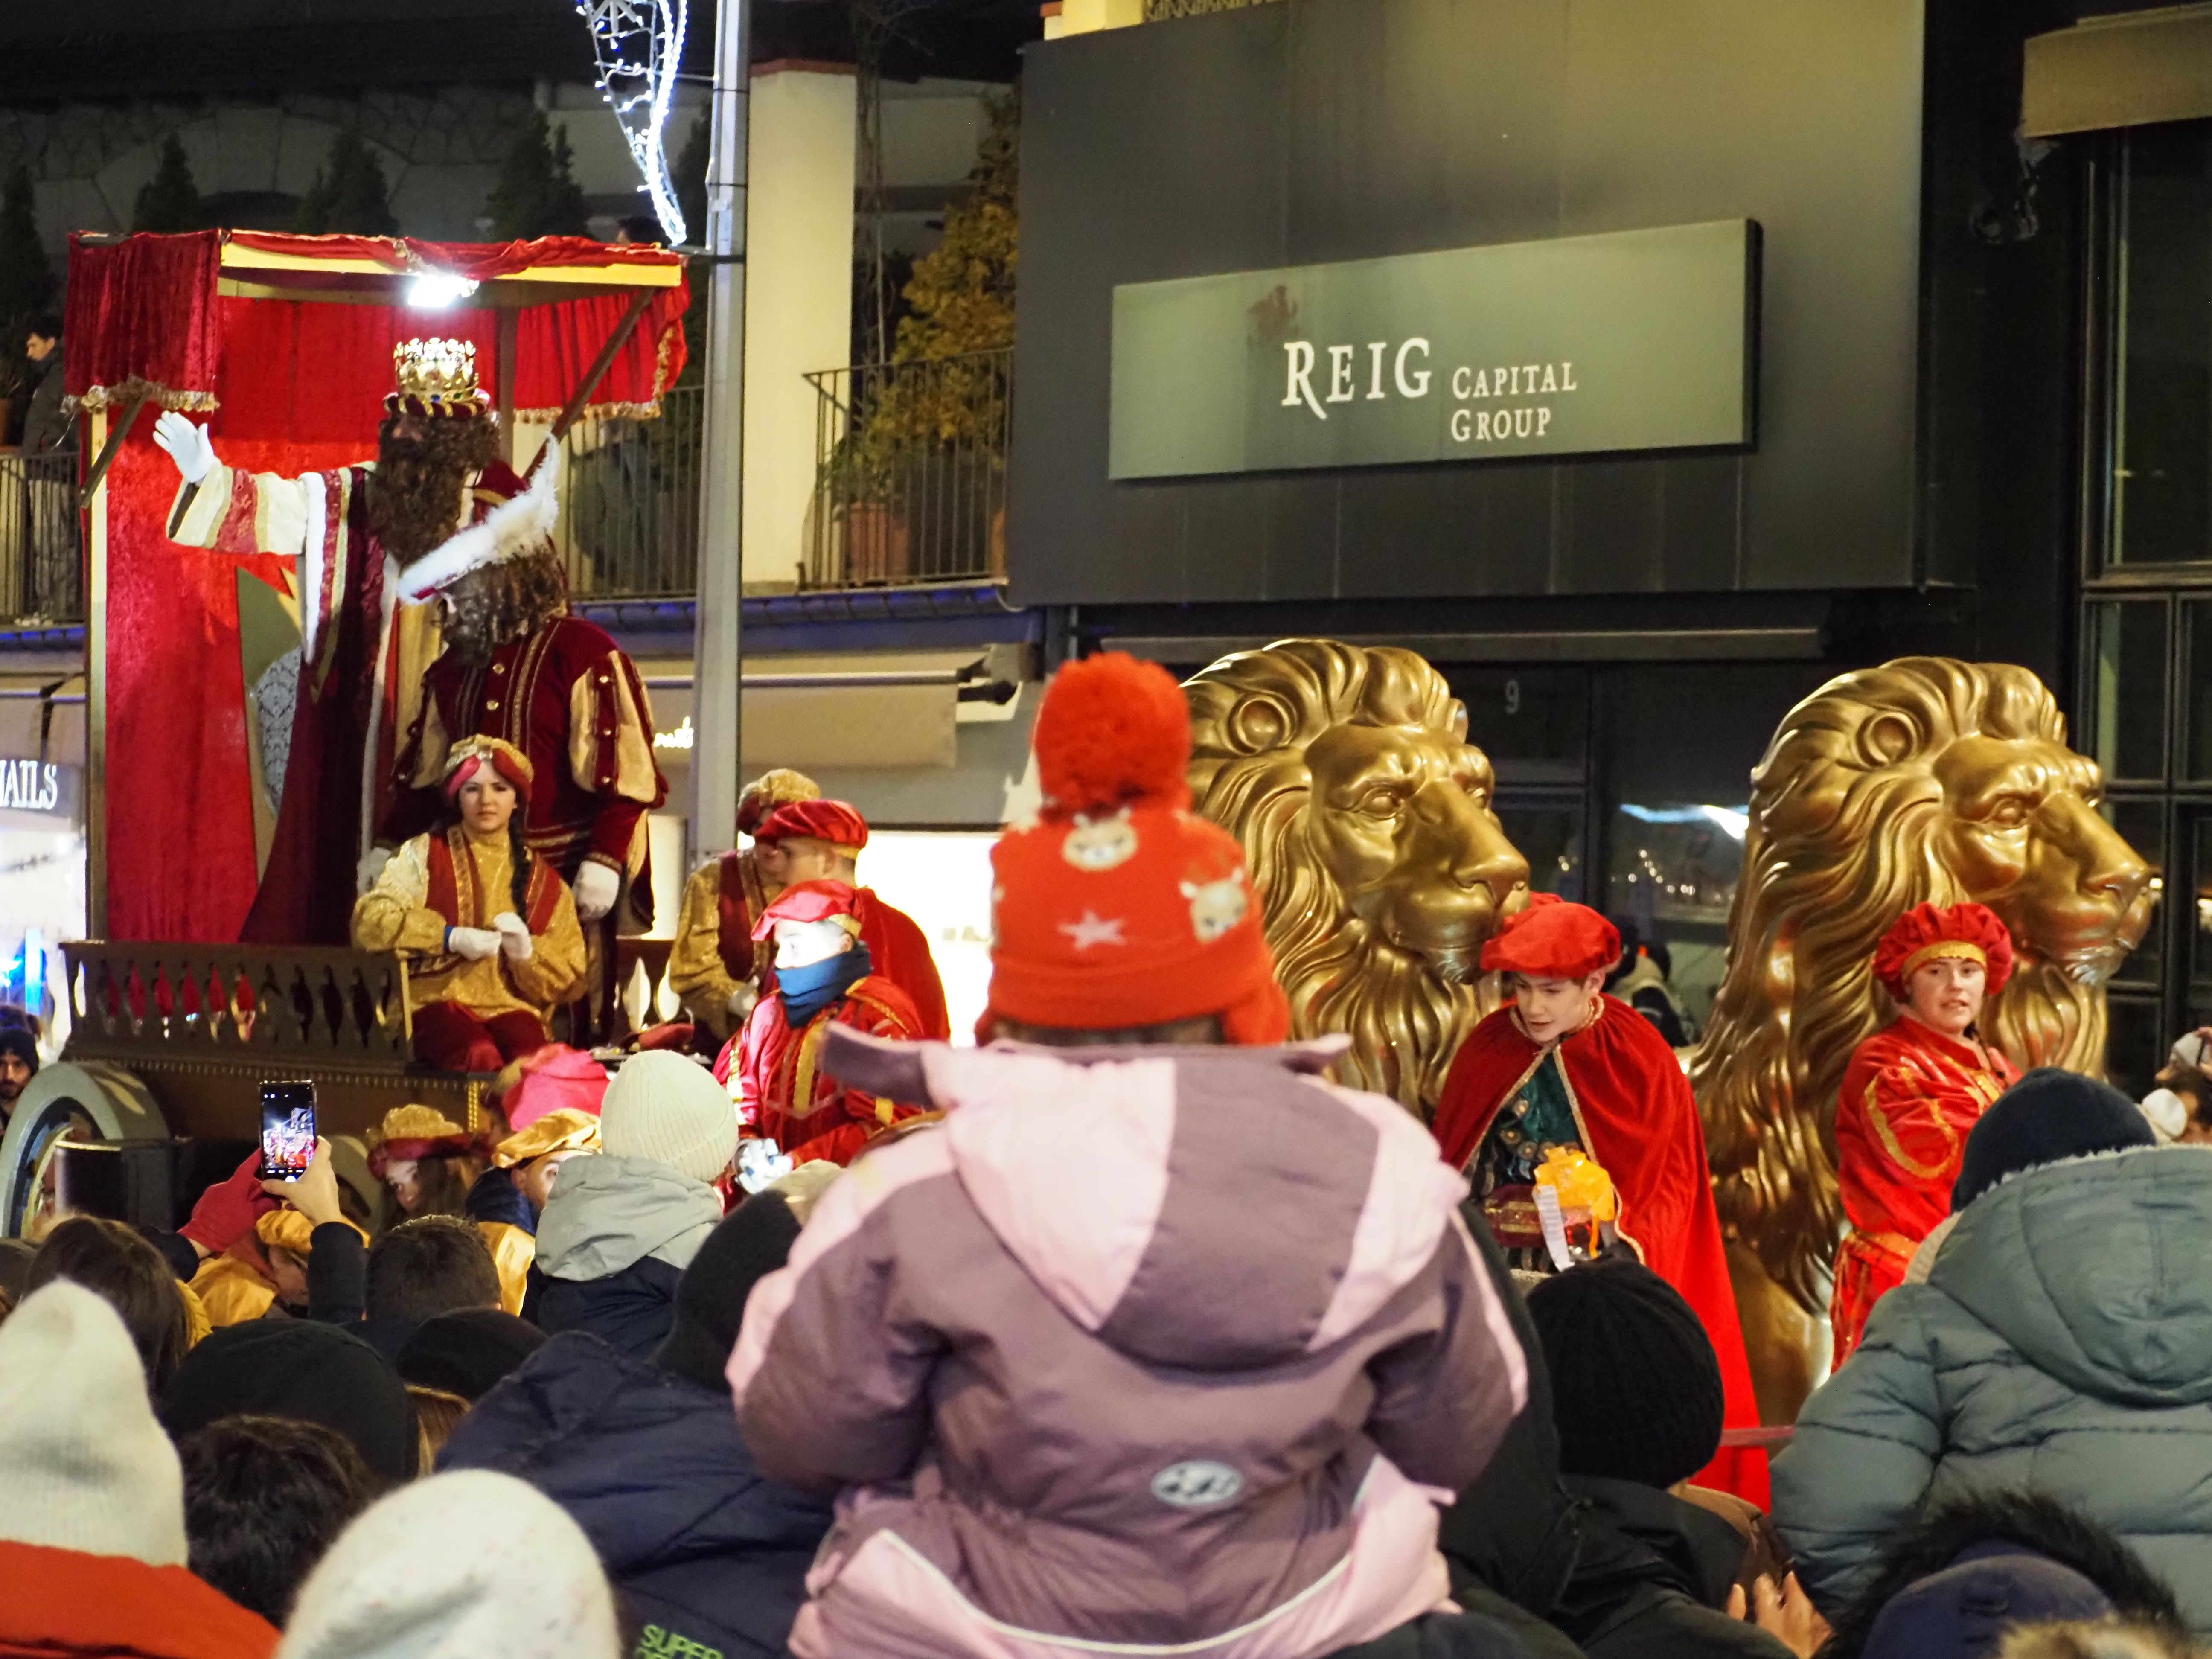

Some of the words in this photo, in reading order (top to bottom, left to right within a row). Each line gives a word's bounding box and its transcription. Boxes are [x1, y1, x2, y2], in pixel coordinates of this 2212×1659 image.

[1281, 338, 1432, 420] REIG
[1452, 362, 1577, 399] CAPITAL
[1451, 407, 1551, 442] GROUP
[1505, 679, 1520, 714] 9
